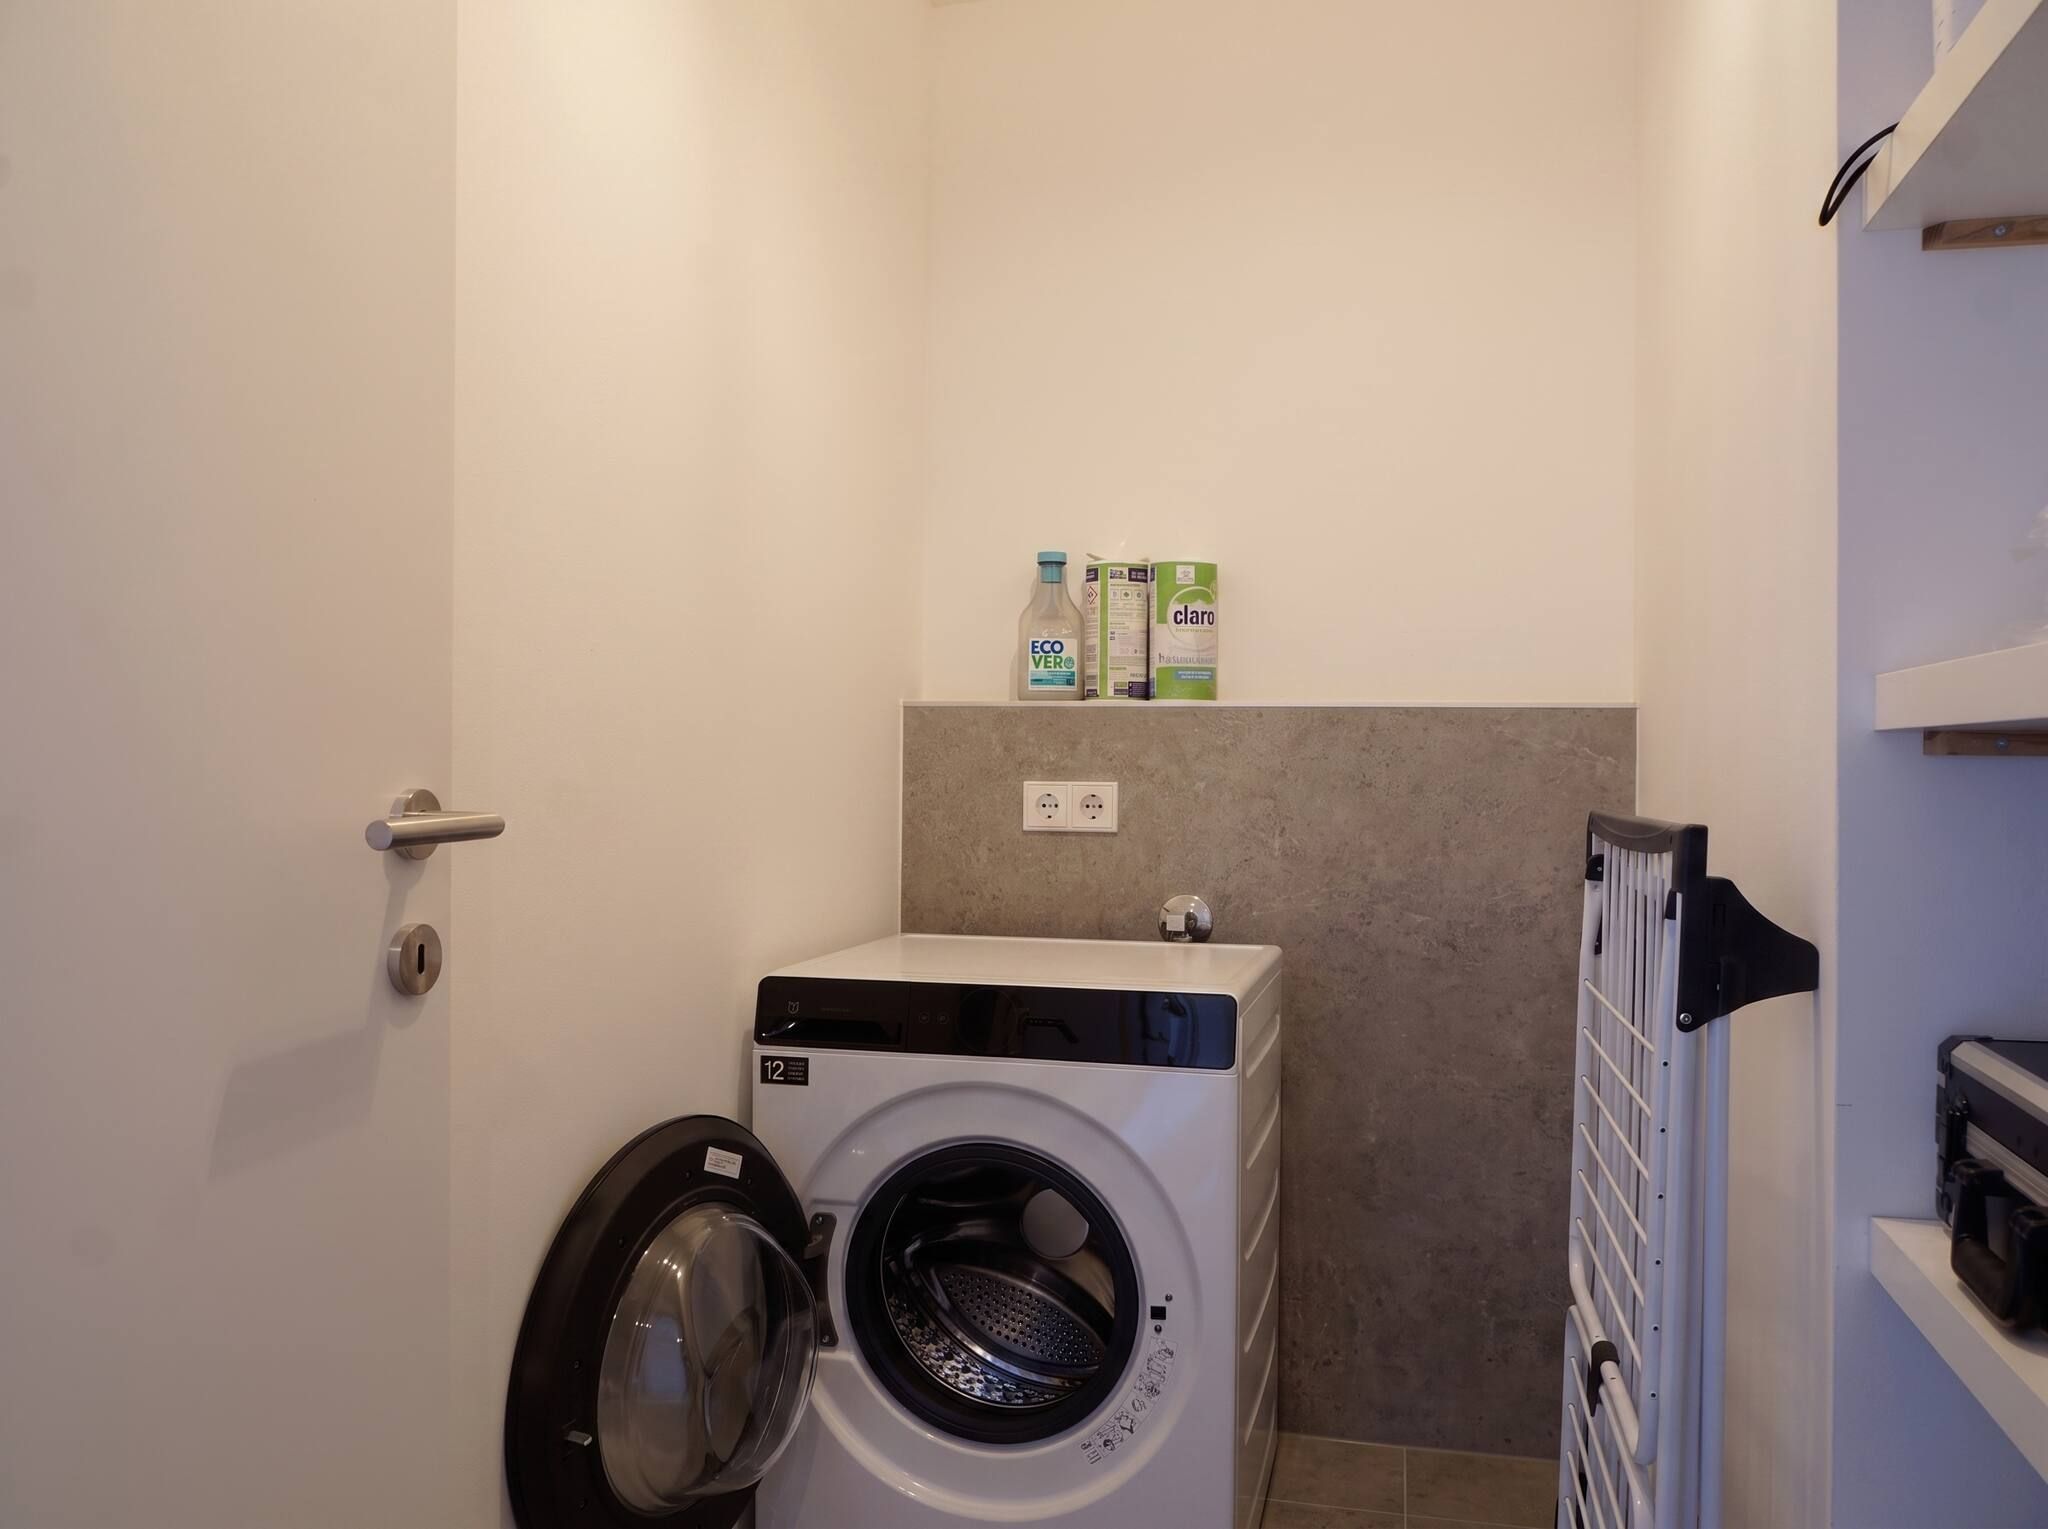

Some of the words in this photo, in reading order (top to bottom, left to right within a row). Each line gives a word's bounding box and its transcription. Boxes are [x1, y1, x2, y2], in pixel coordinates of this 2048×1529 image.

[1173, 604, 1215, 626] claro
[1031, 640, 1064, 655] ECO
[764, 1060, 785, 1080] 12
